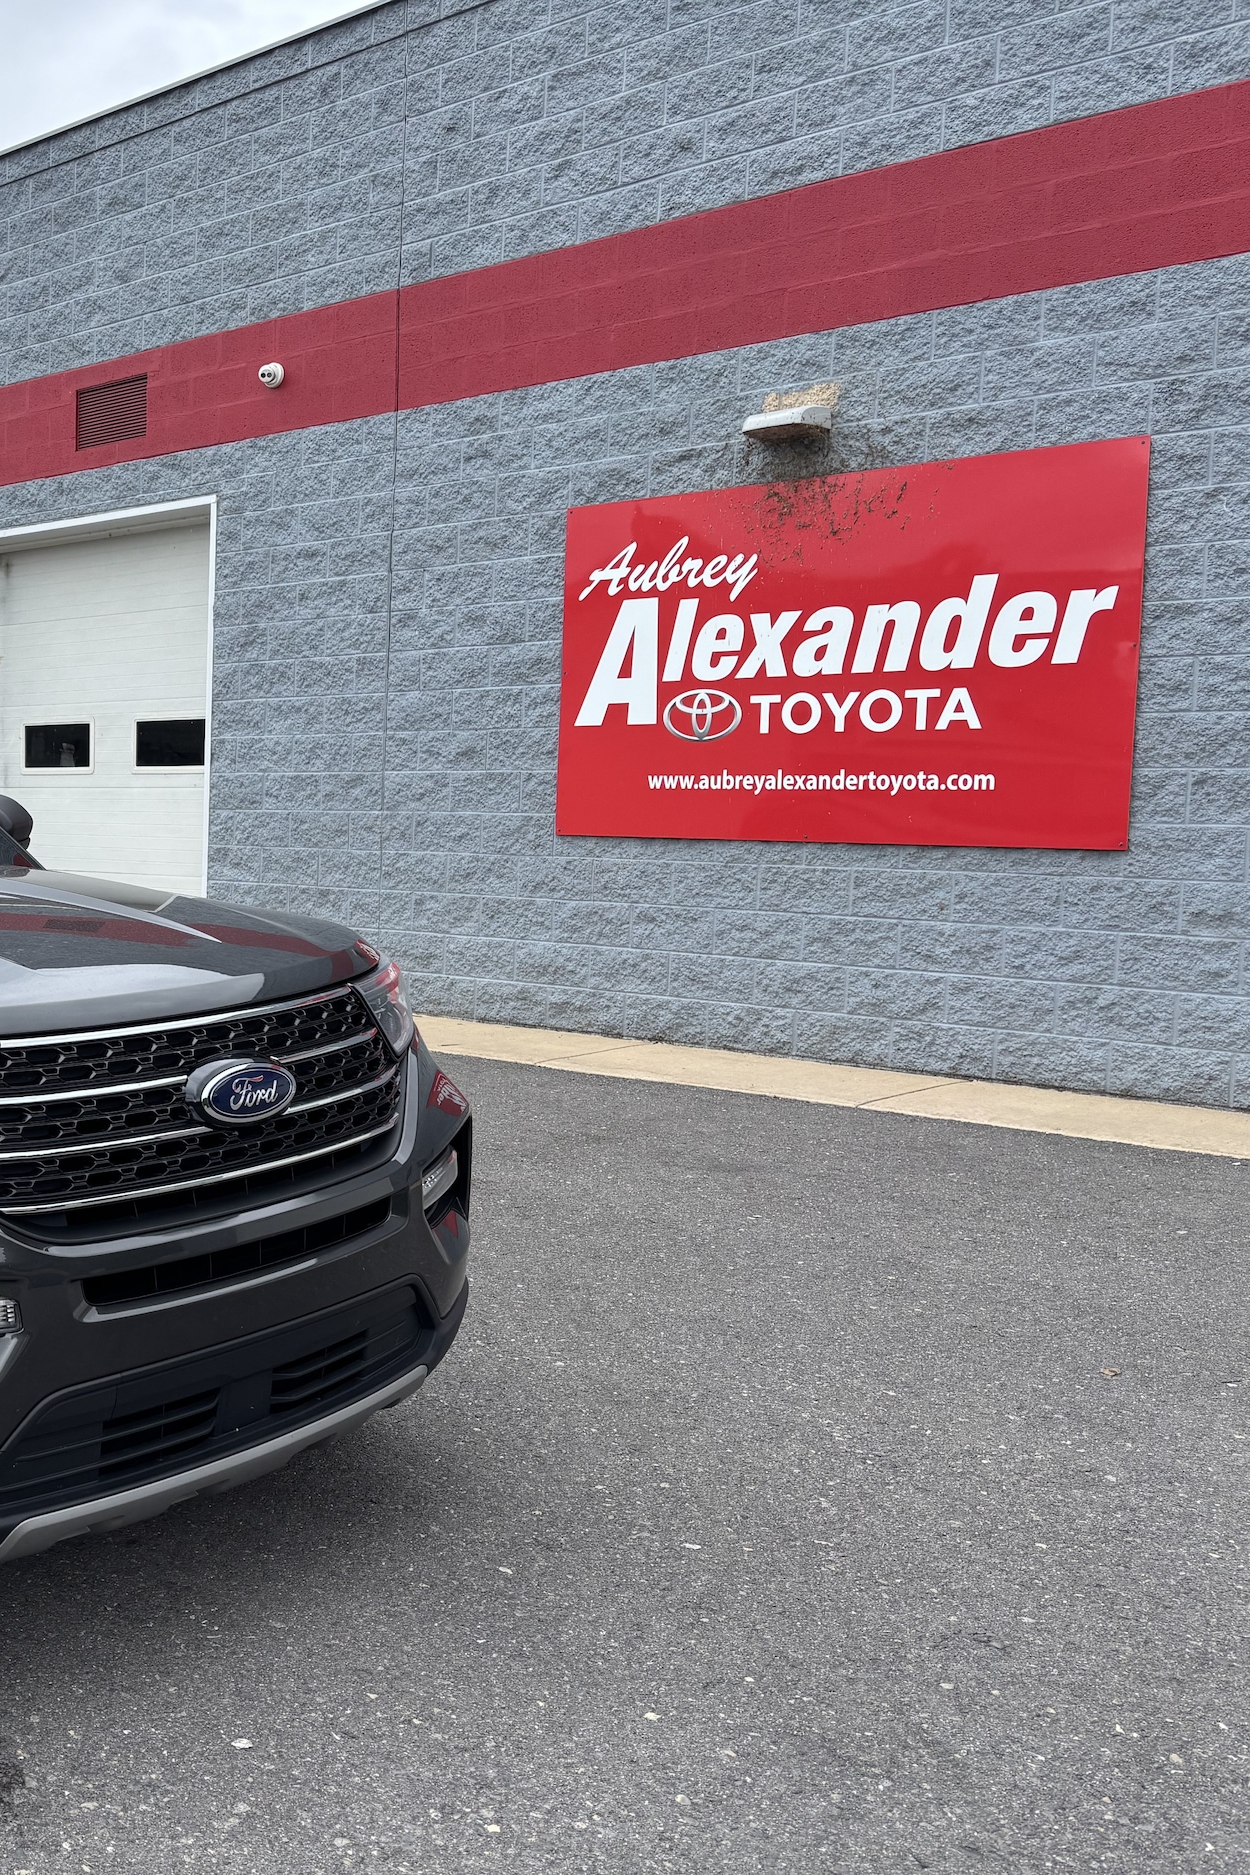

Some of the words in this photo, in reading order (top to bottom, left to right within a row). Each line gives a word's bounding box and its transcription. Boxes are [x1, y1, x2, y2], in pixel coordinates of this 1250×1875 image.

[579, 536, 758, 601] Aubrey
[574, 574, 1119, 727] Alexander
[750, 687, 982, 734] TOYOTA
[647, 768, 995, 795] www.aubreyalexandertoyota.com
[230, 1075, 279, 1110] Ford
